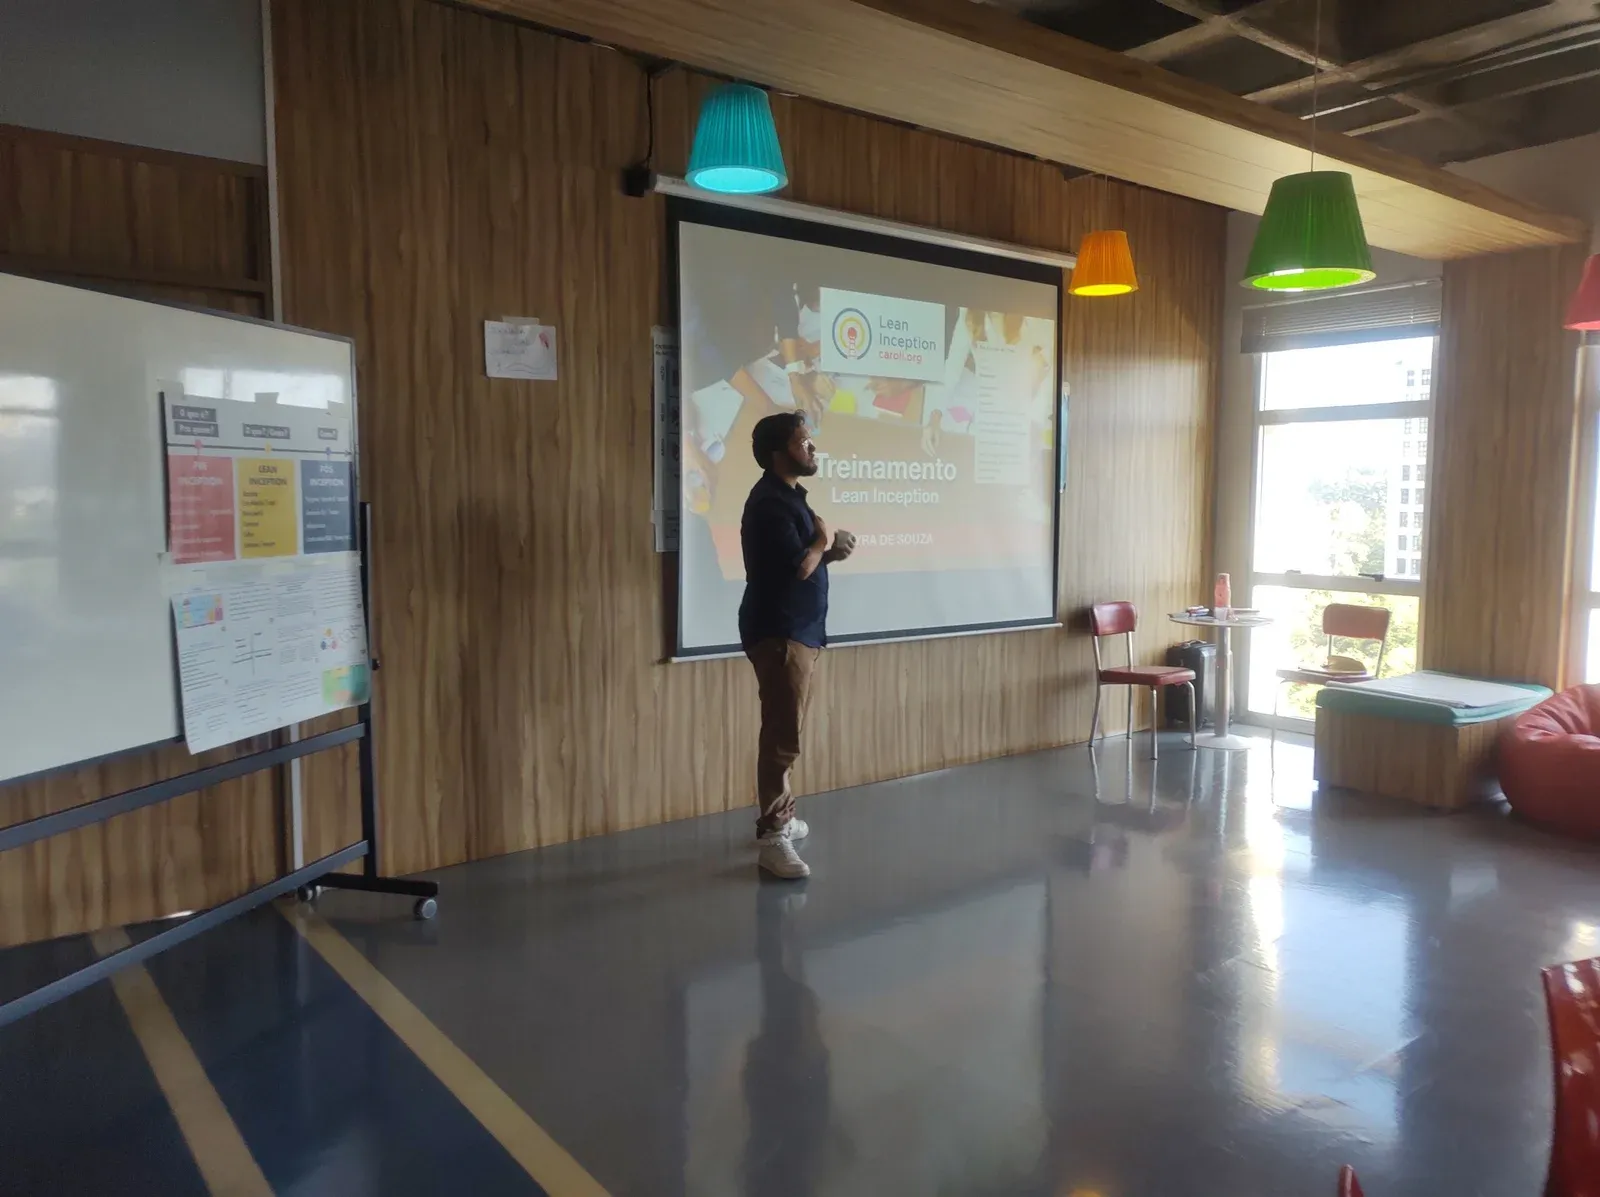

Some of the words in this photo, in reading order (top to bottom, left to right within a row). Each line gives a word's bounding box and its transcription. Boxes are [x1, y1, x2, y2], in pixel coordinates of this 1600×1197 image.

[879, 315, 908, 331] Lean
[879, 333, 937, 350] Inception
[815, 452, 957, 481] Treinamento
[832, 487, 868, 503] Lean
[874, 488, 939, 507] Inception
[880, 533, 894, 546] DE
[896, 532, 933, 545] SOUZA
